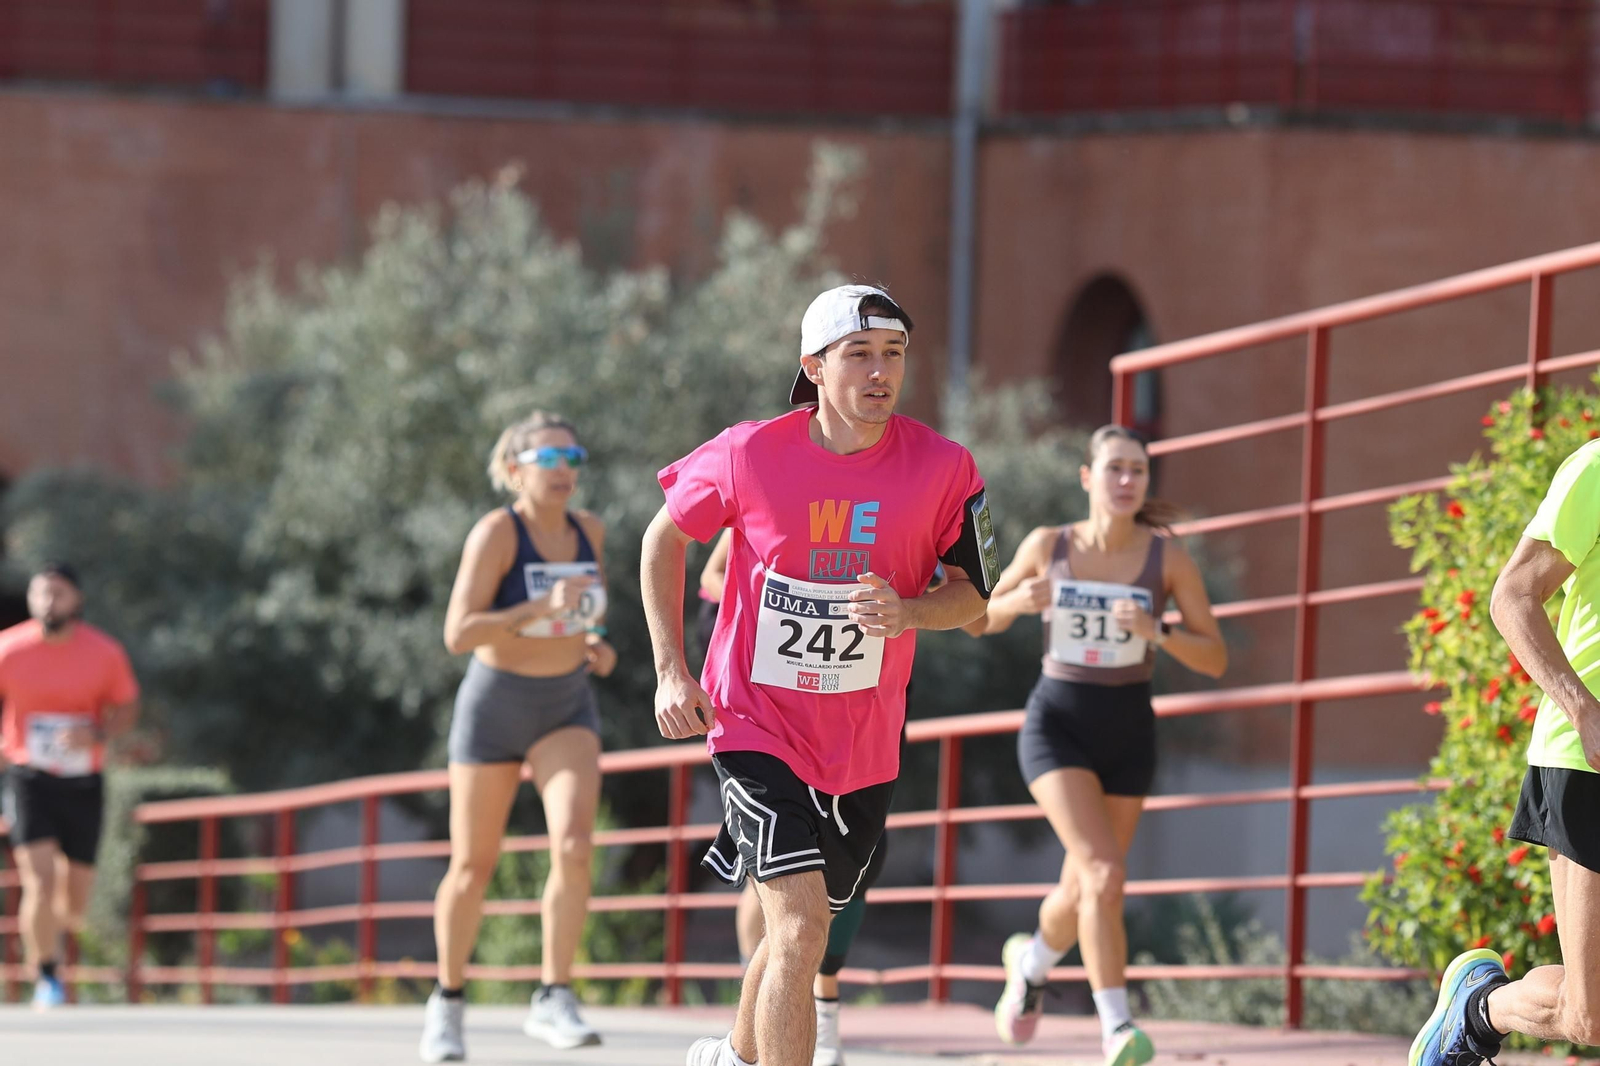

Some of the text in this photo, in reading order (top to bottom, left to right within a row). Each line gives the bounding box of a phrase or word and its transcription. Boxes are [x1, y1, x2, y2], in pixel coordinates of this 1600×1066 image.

[808, 499, 880, 544] WE
[812, 551, 868, 578] RUN
[767, 591, 820, 616] UMA
[791, 590, 826, 600] UNIVERSIDAD
[778, 619, 864, 661] 242
[798, 675, 820, 687] WE
